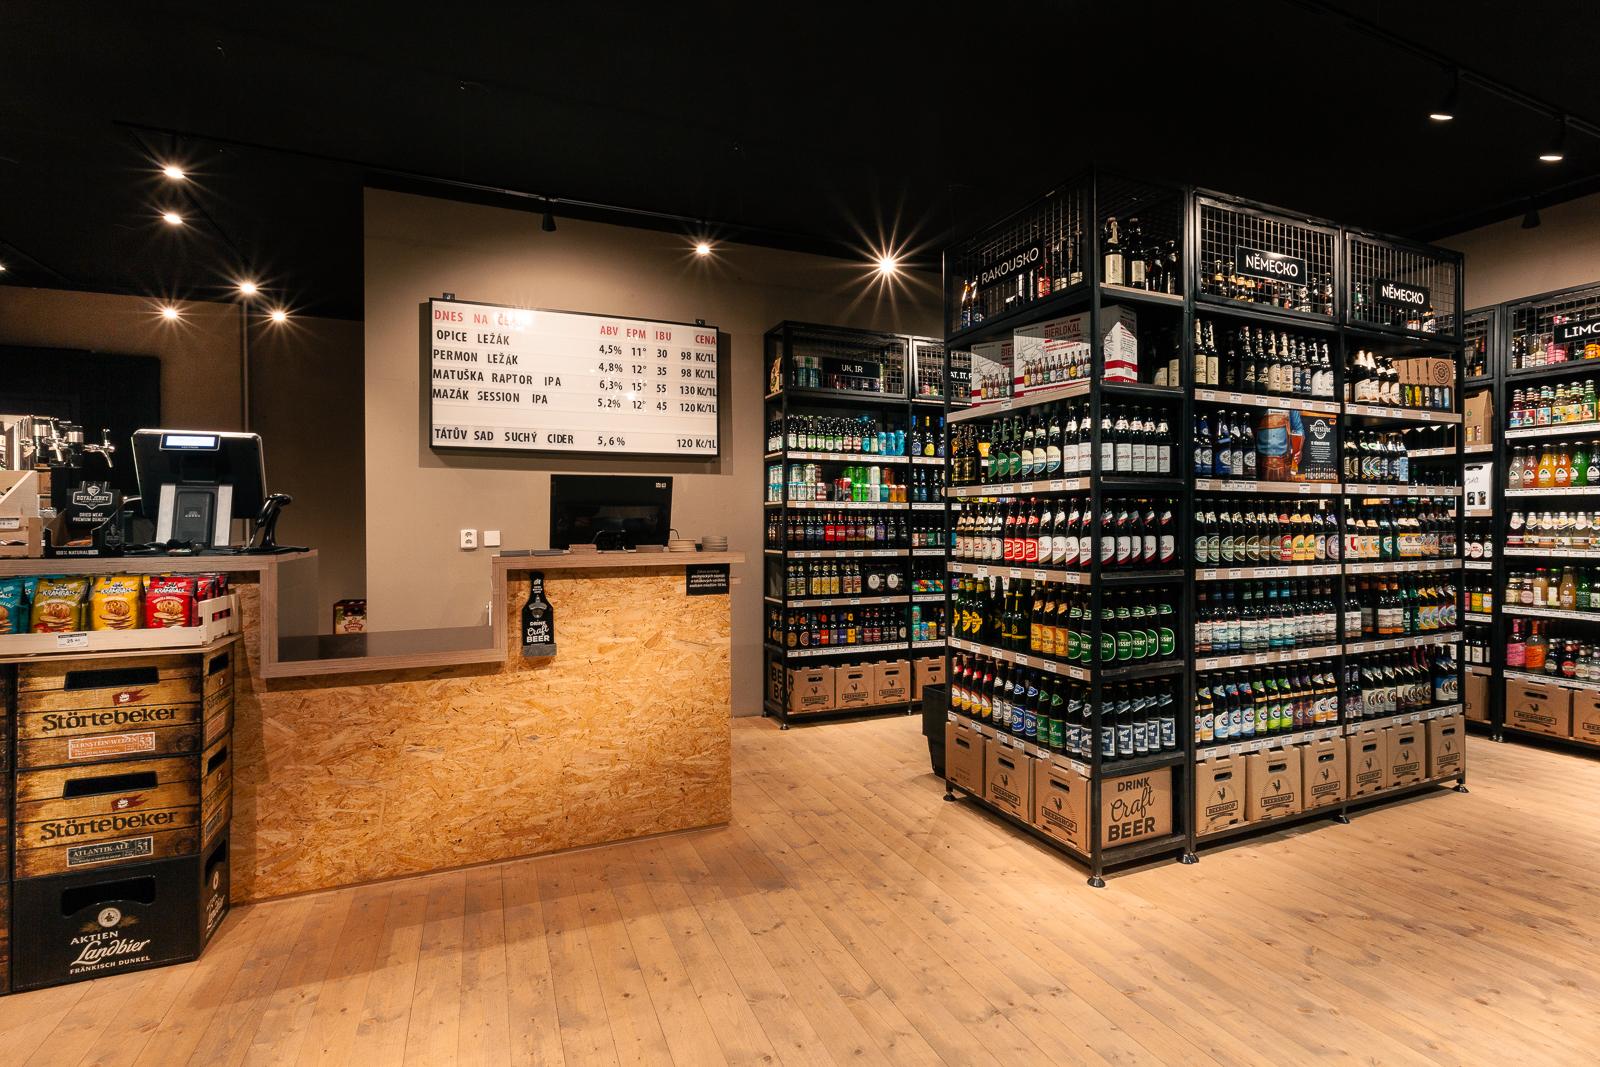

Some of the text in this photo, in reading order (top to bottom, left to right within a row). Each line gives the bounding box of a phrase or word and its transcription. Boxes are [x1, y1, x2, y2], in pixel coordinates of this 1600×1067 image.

[981, 247, 1039, 285] RAKOUSKO
[1246, 253, 1298, 277] NĚMECKO
[1382, 284, 1424, 304] NĚMECKO
[434, 310, 464, 322] DNES
[474, 313, 488, 325] NA
[600, 326, 716, 345] ABV EPM IBU CENA
[1044, 322, 1080, 338] BIERLOKAL
[436, 329, 468, 342] OPICE
[477, 333, 510, 346] LEŽÁK
[599, 344, 622, 355] 4,5%
[632, 347, 647, 356] 11°
[656, 349, 668, 358] 30
[680, 351, 692, 360] 98
[433, 349, 478, 362] PERMON
[487, 352, 518, 366] LEŽÁK
[598, 362, 623, 372] 4,8%
[632, 365, 647, 374] 12°
[656, 366, 667, 376] 35
[681, 369, 692, 378] 98
[855, 365, 863, 373] IR
[432, 368, 484, 382] MATUŠKA
[491, 372, 533, 385] RAPTOR
[544, 376, 562, 386] IPA
[600, 380, 623, 391] 6,3%
[632, 382, 648, 392] 15°
[656, 384, 667, 393] 55
[680, 385, 695, 395] 130
[432, 388, 469, 400] MAZÁK
[477, 391, 520, 403] SESSION
[532, 394, 548, 404] IPA
[597, 398, 621, 408] 5,2%
[632, 400, 647, 410] 12°
[656, 402, 667, 411] 45
[680, 403, 696, 412] 120
[434, 427, 468, 440] TÁTŮV
[474, 430, 494, 441] SAD
[504, 431, 537, 443] SUCHÝ
[547, 433, 574, 444] CIDER
[677, 439, 693, 448] 120
[526, 635, 550, 643] BEER
[527, 624, 549, 636] Craft
[42, 707, 179, 734] Störtebeker
[1117, 776, 1150, 793] DRINK
[1313, 783, 1338, 794] BEERSHOP
[1111, 786, 1155, 822] Craft
[1208, 802, 1236, 815] BEERSHOP
[1263, 794, 1292, 805] BEERSHOP
[40, 810, 178, 841] Störtebeker
[1044, 809, 1074, 829] BEERSHOP
[1108, 816, 1156, 843] BEER
[70, 930, 119, 946] AKTIEN
[70, 938, 151, 966] Landbier
[70, 955, 151, 975] FRÄNKISCH DUNKEL
